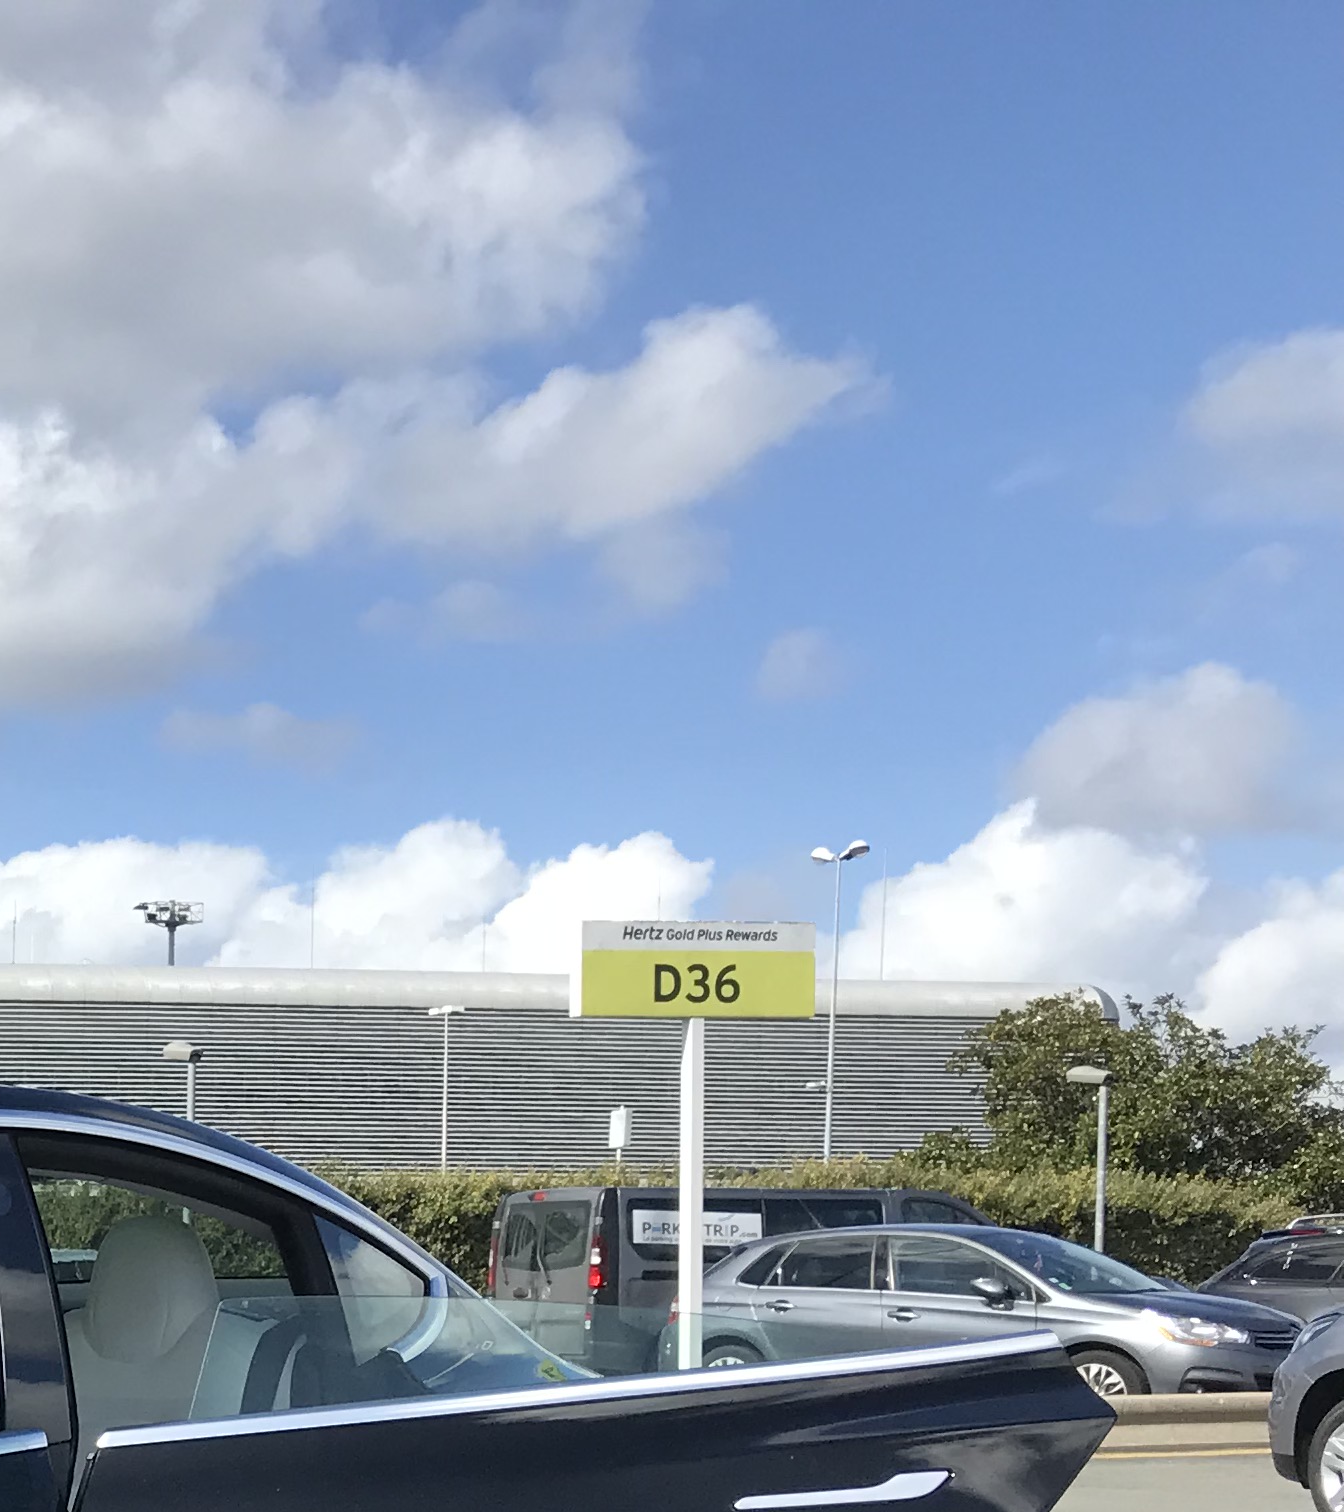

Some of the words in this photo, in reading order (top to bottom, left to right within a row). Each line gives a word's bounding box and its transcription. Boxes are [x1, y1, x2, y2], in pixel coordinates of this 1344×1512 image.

[623, 926, 663, 941] Hertz
[666, 928, 694, 942] Gold
[697, 929, 723, 942] Plus
[725, 929, 779, 942] Rewards
[654, 963, 741, 1004] D36
